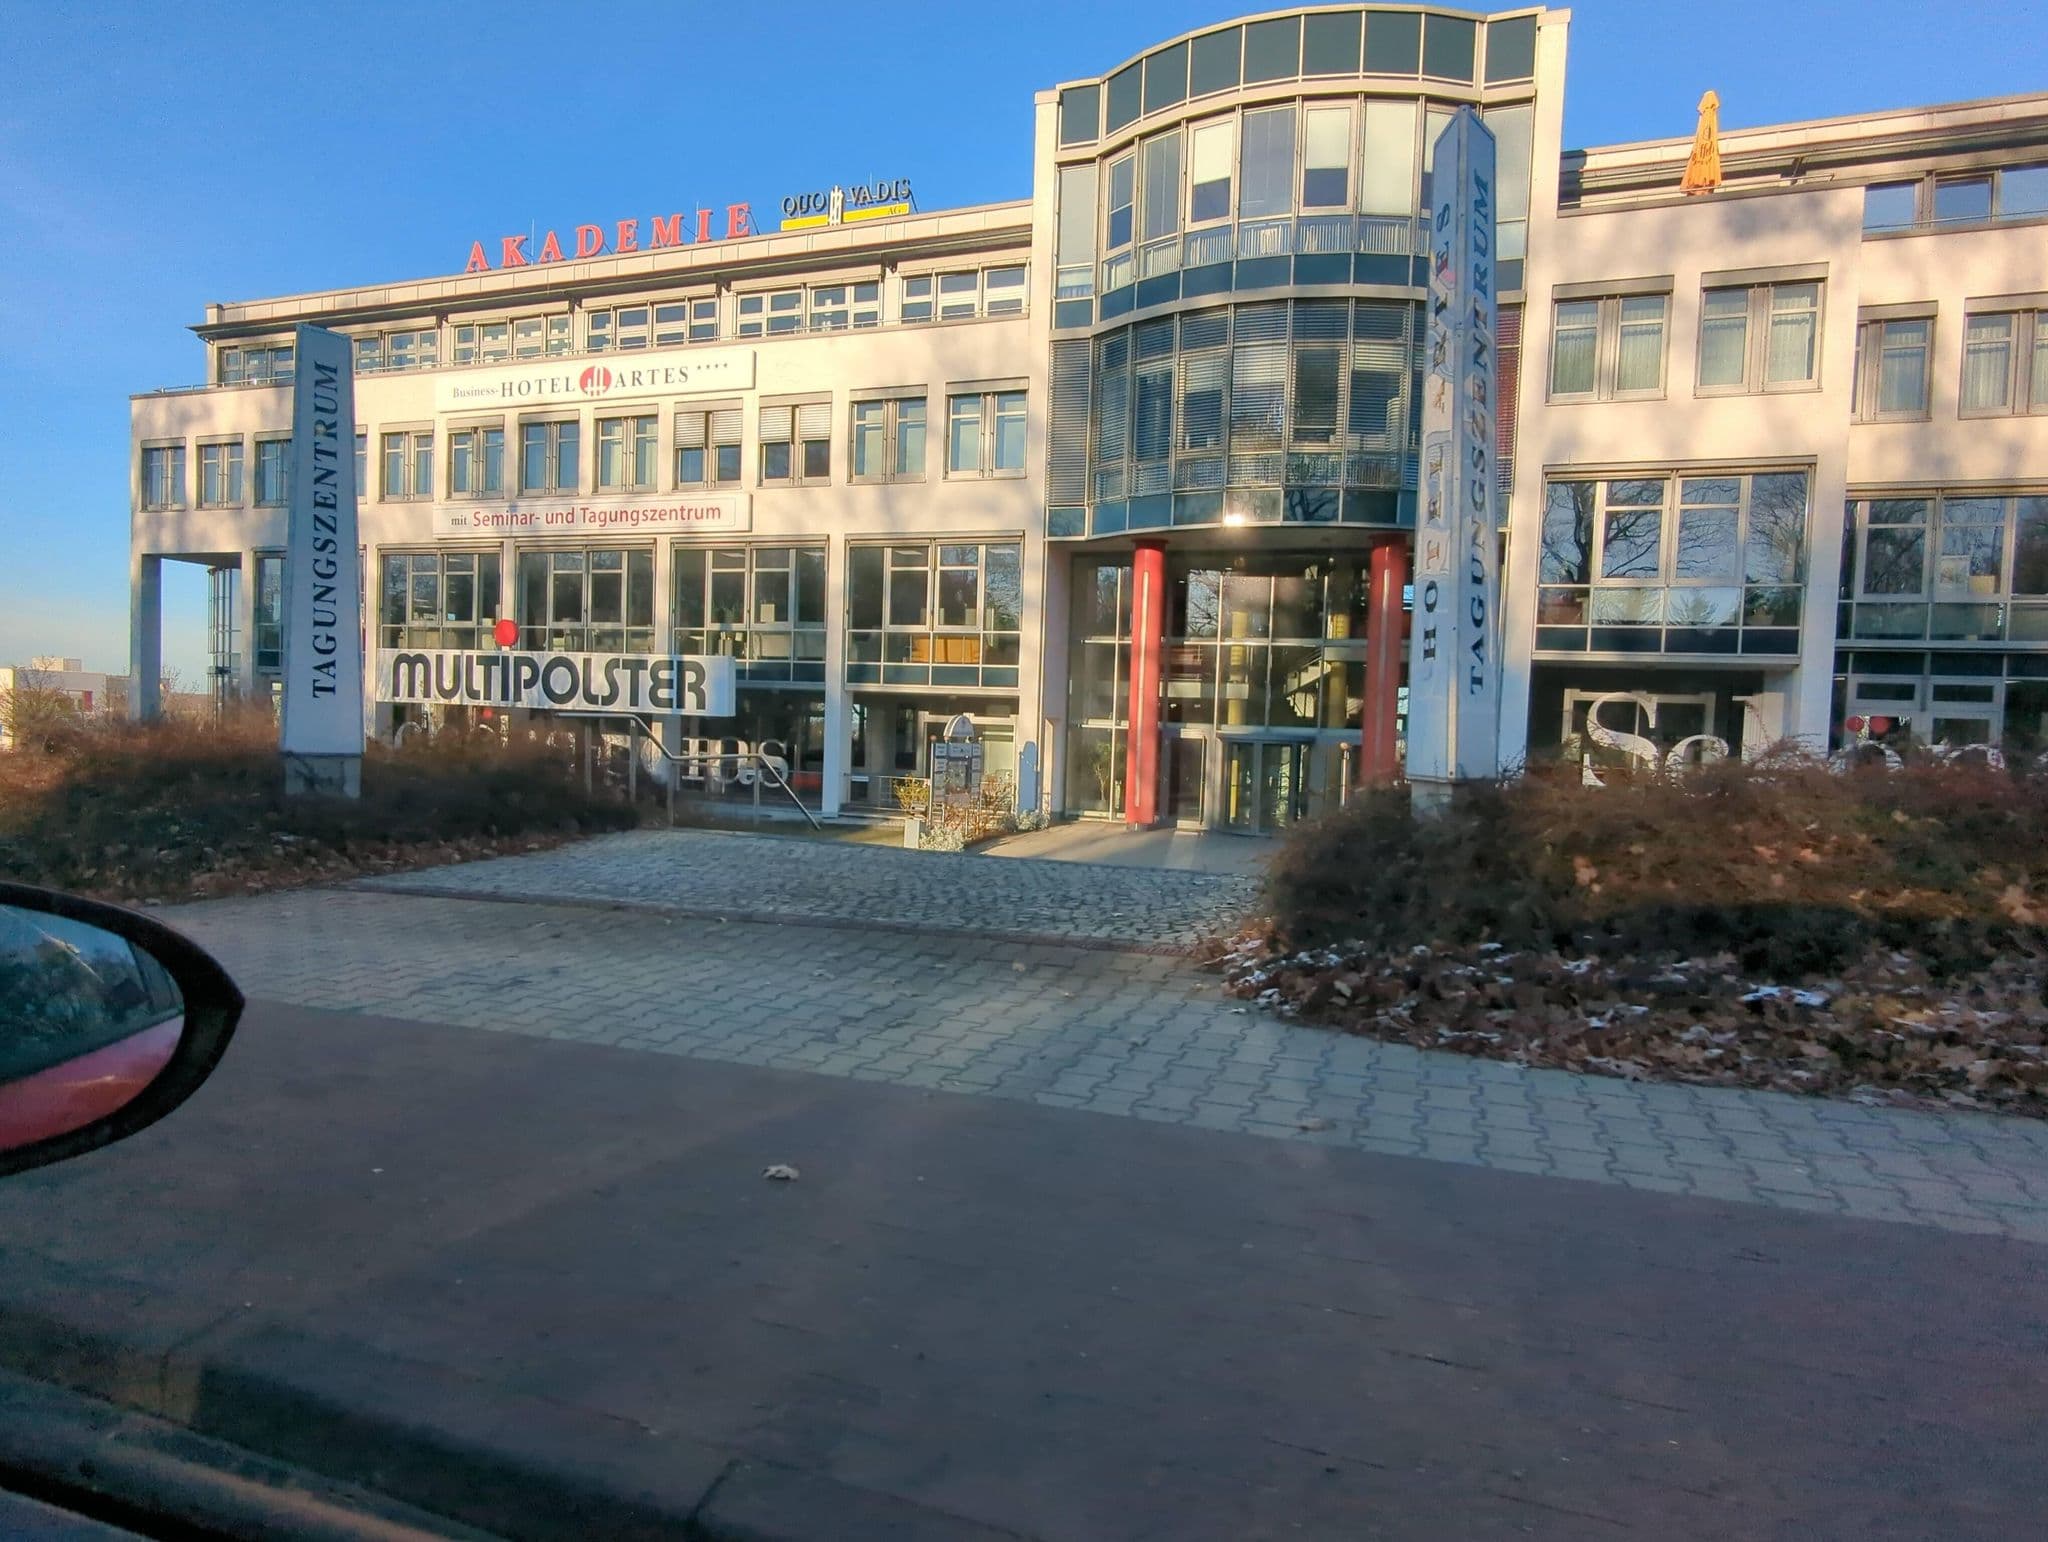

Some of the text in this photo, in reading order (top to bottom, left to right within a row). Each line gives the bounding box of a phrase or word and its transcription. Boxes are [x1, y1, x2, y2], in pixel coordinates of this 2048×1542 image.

[782, 178, 911, 217] QUO VADIS
[465, 203, 752, 273] AKADEMIE
[501, 376, 576, 398] HOTEL
[615, 366, 689, 388] ARTES
[1470, 169, 1489, 695] TAGUNGSZENTRUM
[312, 360, 338, 698] TAGUNGSZENTRUM
[451, 505, 721, 528] mit Seminar- und Tagungszentrum
[392, 653, 706, 709] MULTIPOLSTER
